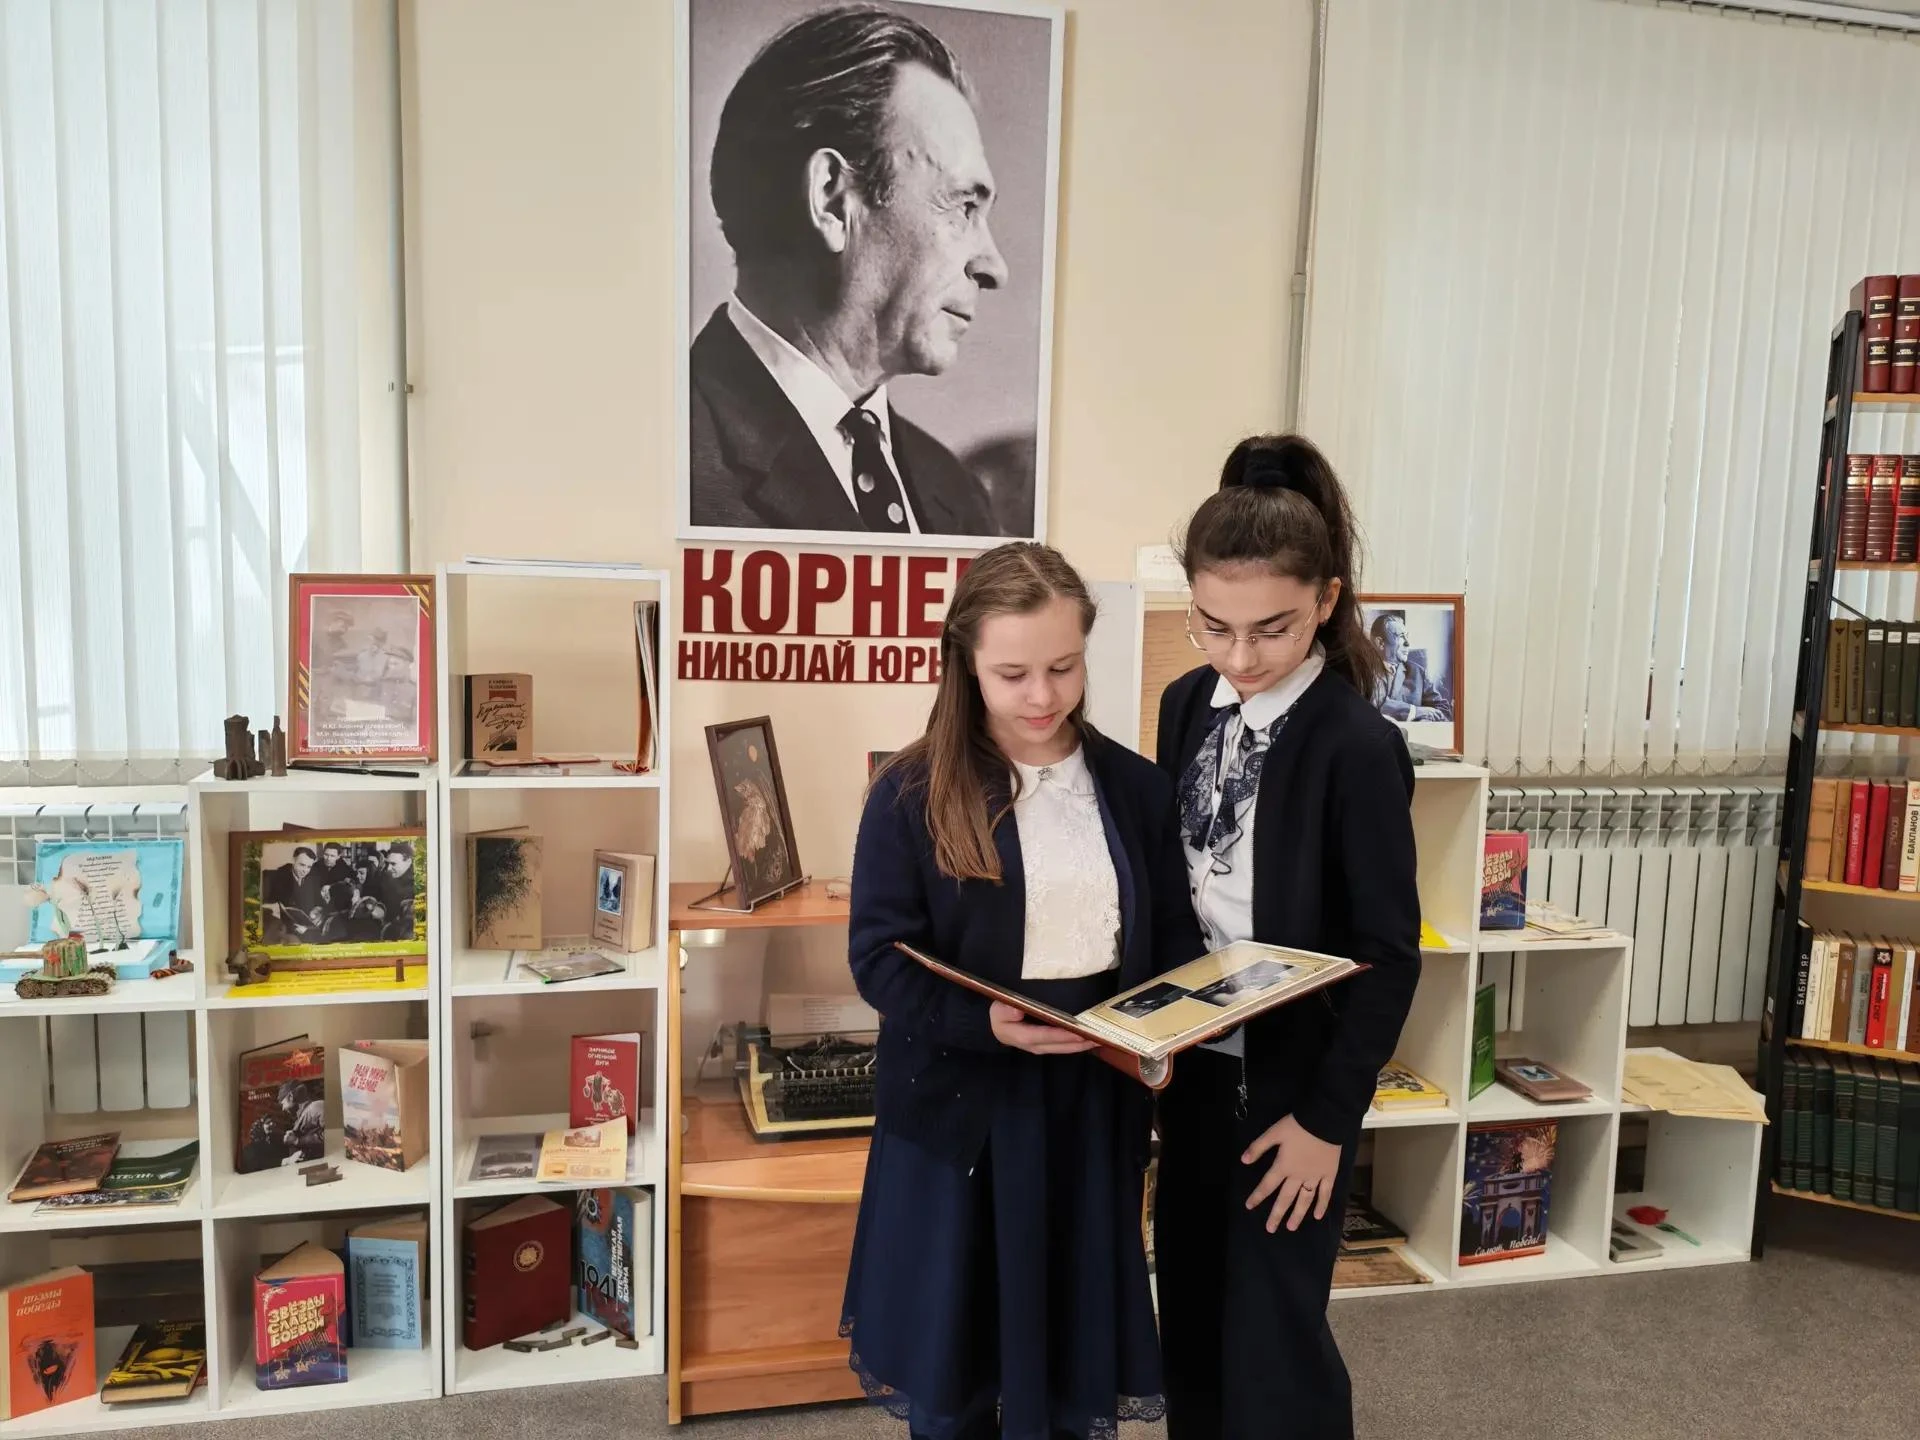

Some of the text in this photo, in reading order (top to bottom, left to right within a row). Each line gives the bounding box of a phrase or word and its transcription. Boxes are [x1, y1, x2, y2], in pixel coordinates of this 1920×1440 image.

[678, 639, 856, 682] НИКОЛАЙ
[1907, 810, 1919, 855] БАКЛАНОВ
[1796, 954, 1809, 1006] БАБИЙ ЯР
[268, 1308, 318, 1335] СЛАВЫ
[271, 1316, 325, 1348] БОЕВОЙ
